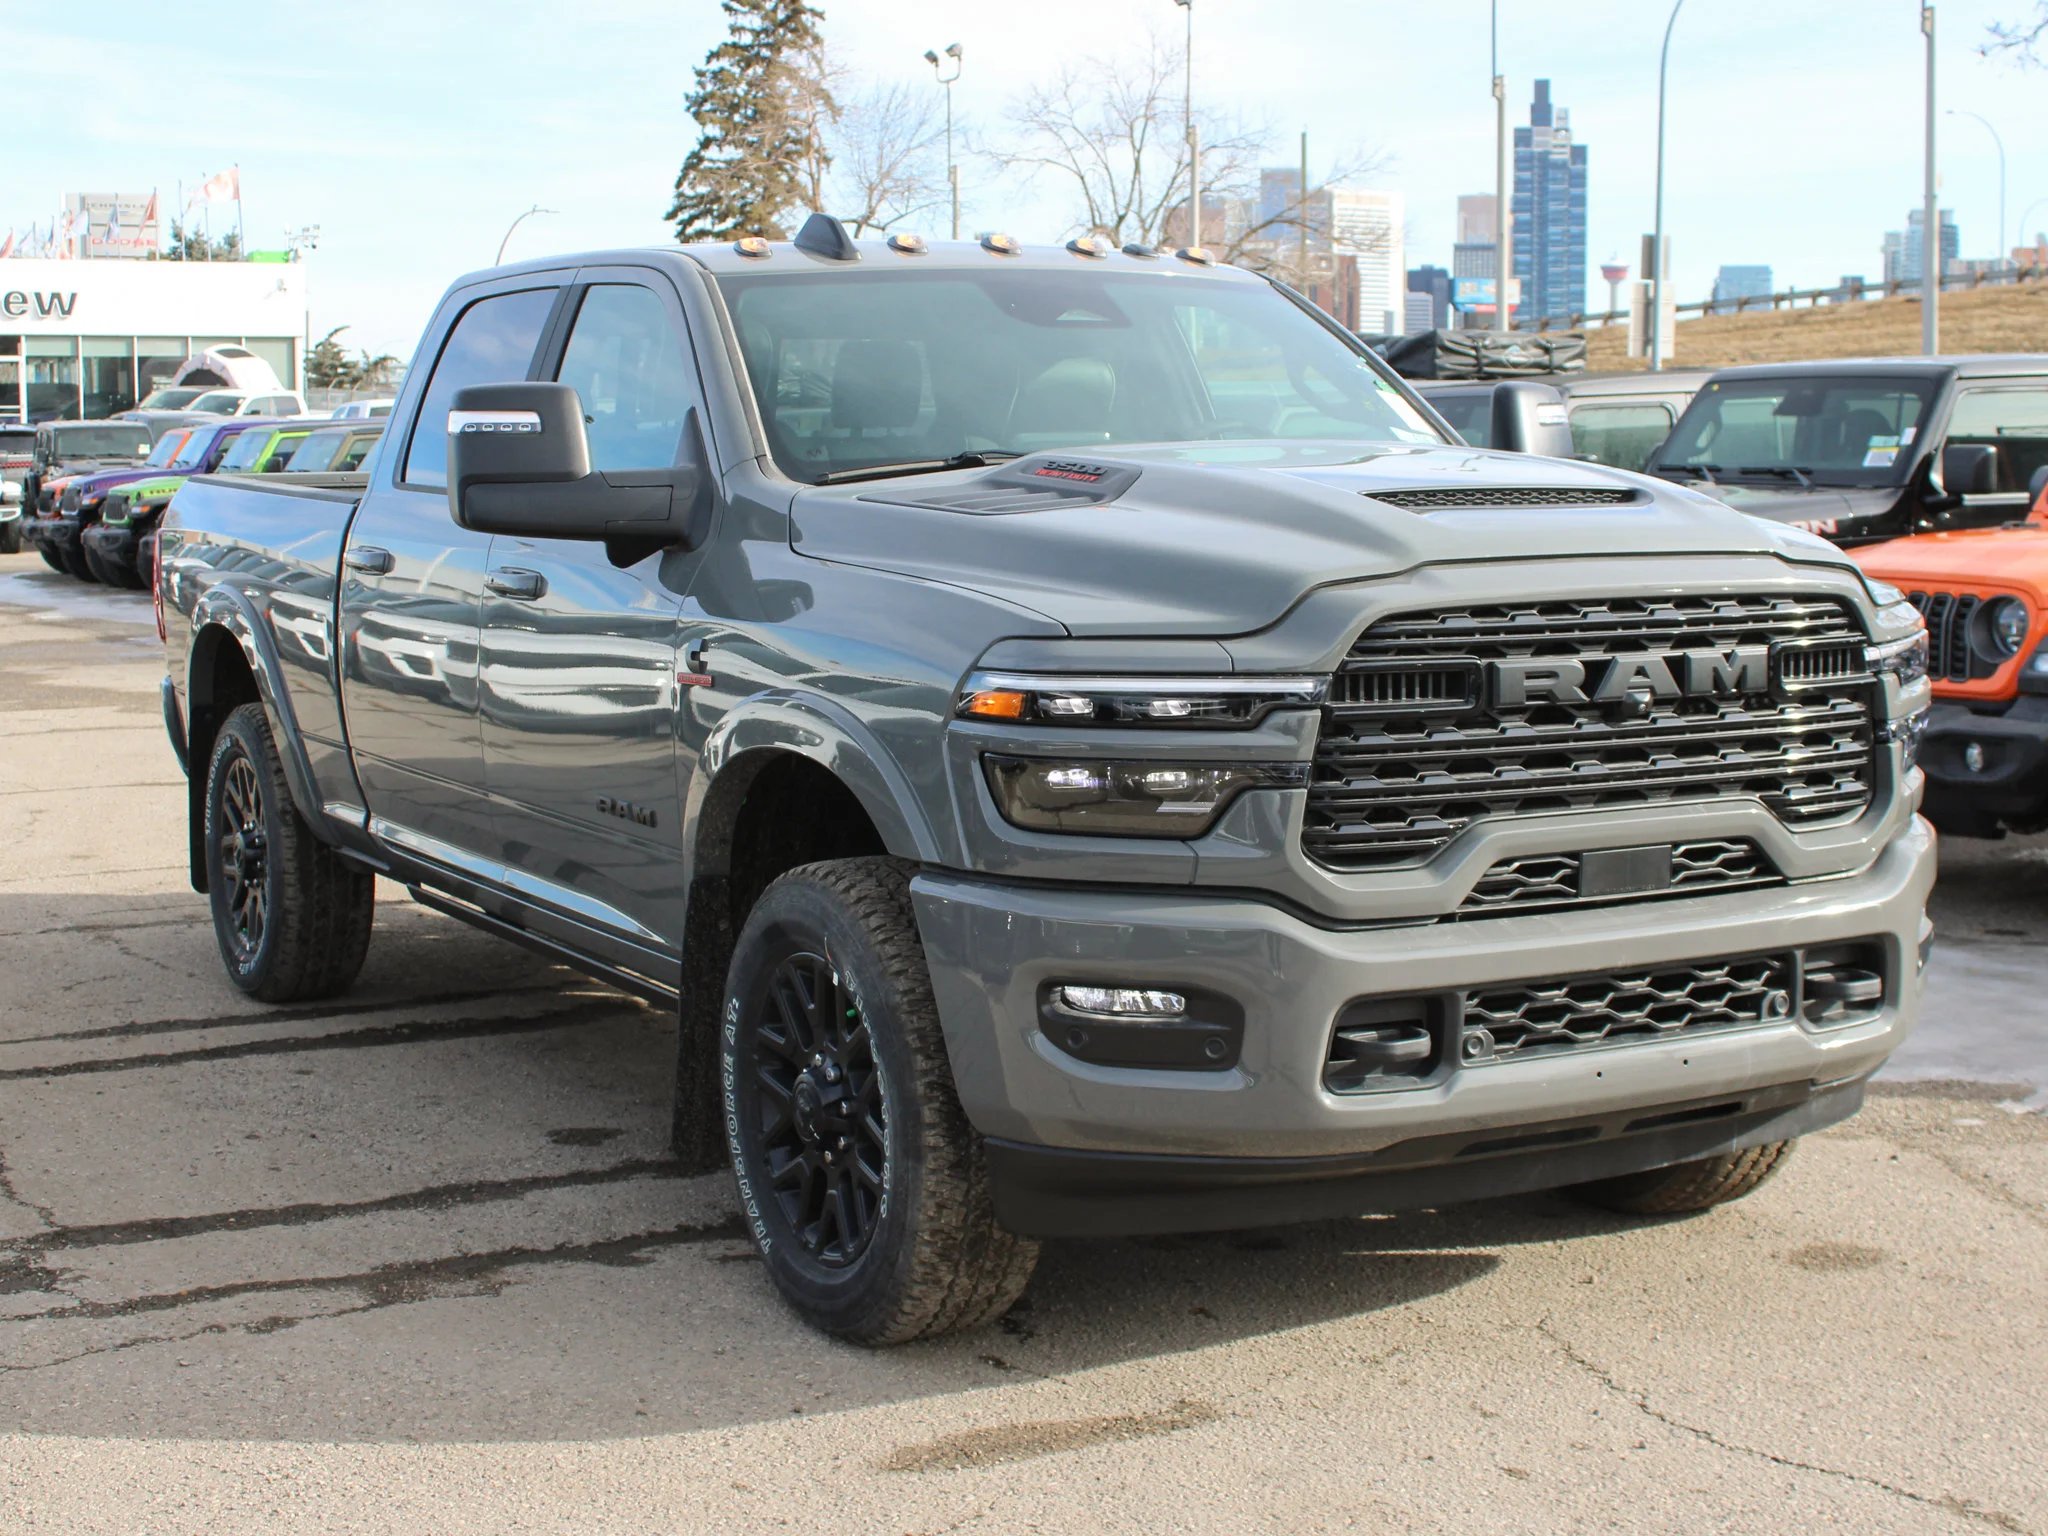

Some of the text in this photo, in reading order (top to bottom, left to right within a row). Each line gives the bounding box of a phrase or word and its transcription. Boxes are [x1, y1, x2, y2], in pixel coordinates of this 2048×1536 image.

[3, 290, 77, 317] ew
[1035, 469, 1100, 482] HEAVY DUTY
[1493, 646, 1769, 707] RAM
[596, 795, 657, 828] RAM
[723, 1052, 772, 1255] TRANSFORCE
